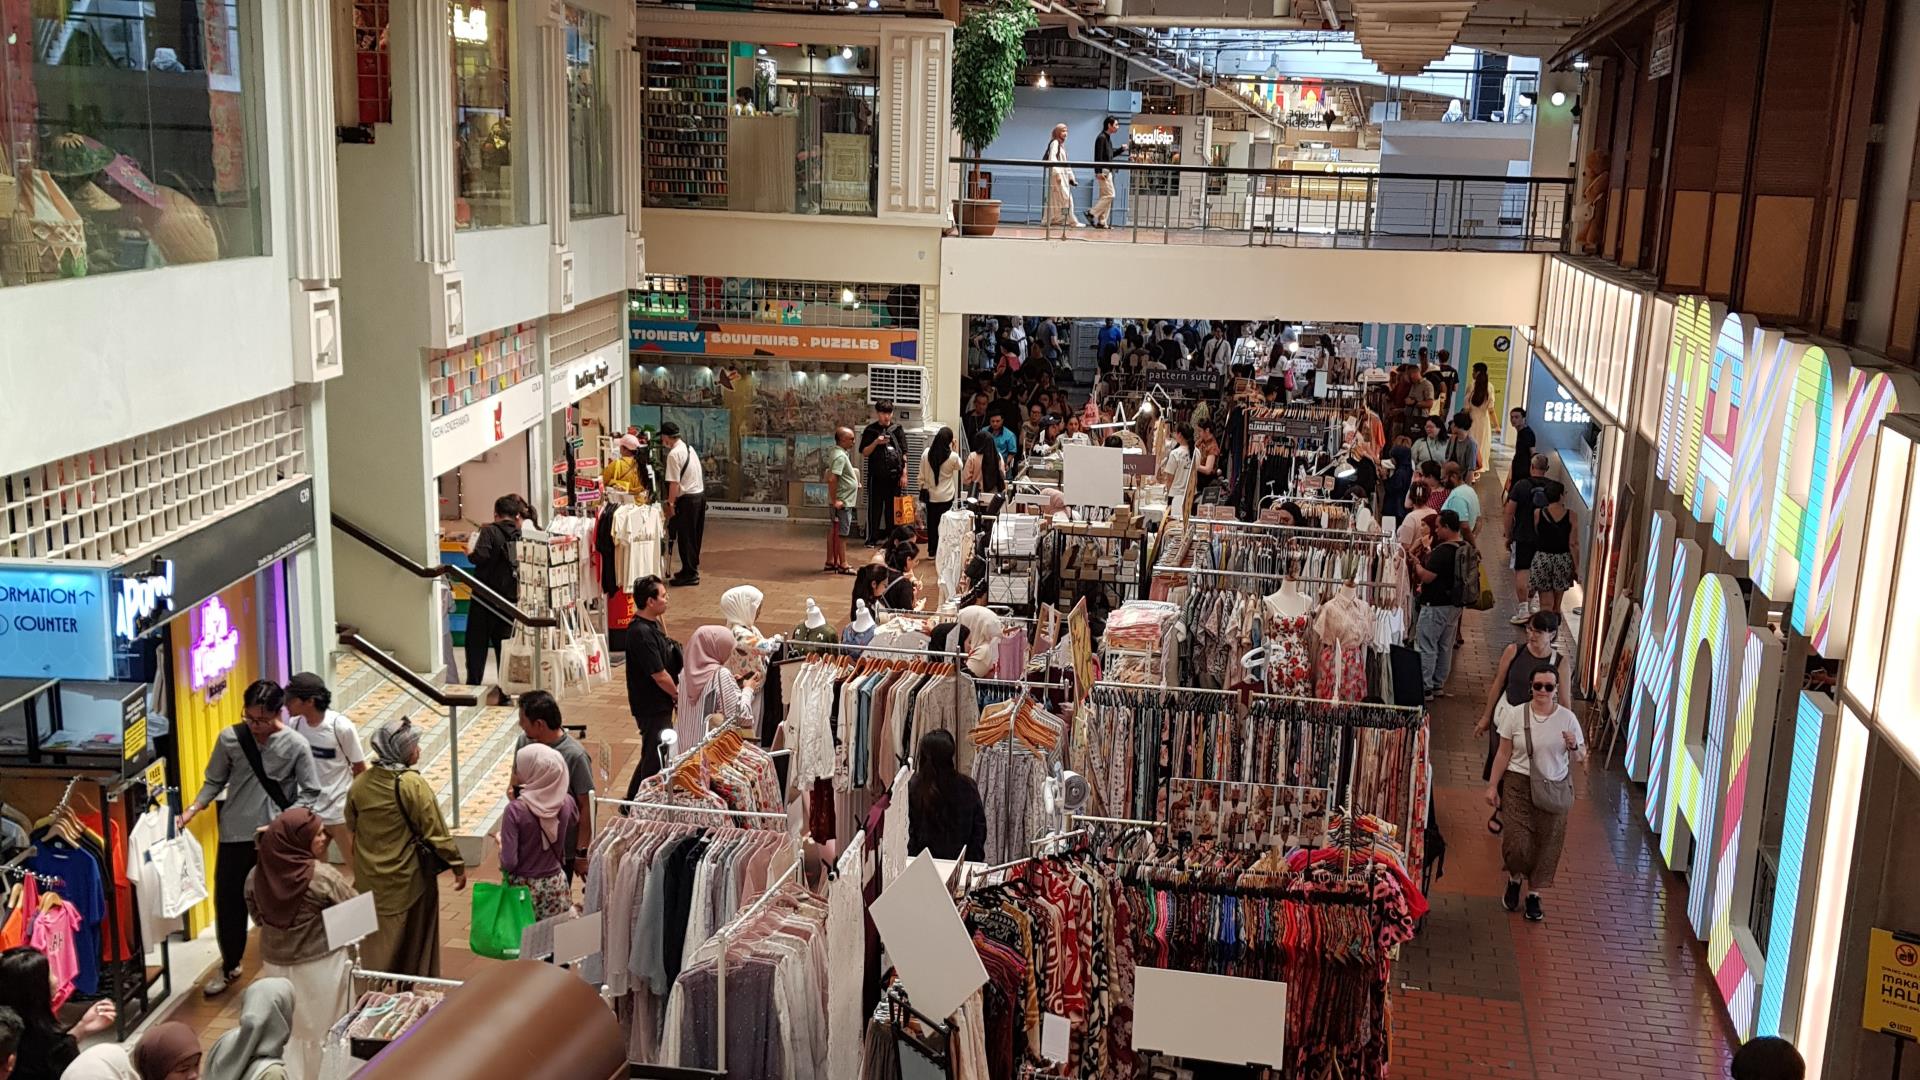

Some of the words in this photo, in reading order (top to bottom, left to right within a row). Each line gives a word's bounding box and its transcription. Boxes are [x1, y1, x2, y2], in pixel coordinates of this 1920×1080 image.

[711, 333, 799, 347] SOUVENIRS
[810, 336, 879, 350] PUZZLES
[1149, 371, 1187, 381] pattern
[1190, 373, 1217, 382] sutra
[1545, 401, 1583, 413] PASA
[1248, 423, 1274, 432] CLEARANCE
[1274, 425, 1286, 433] SALE
[14, 615, 78, 633] COUNTER
[1882, 974, 1920, 990] MAKA
